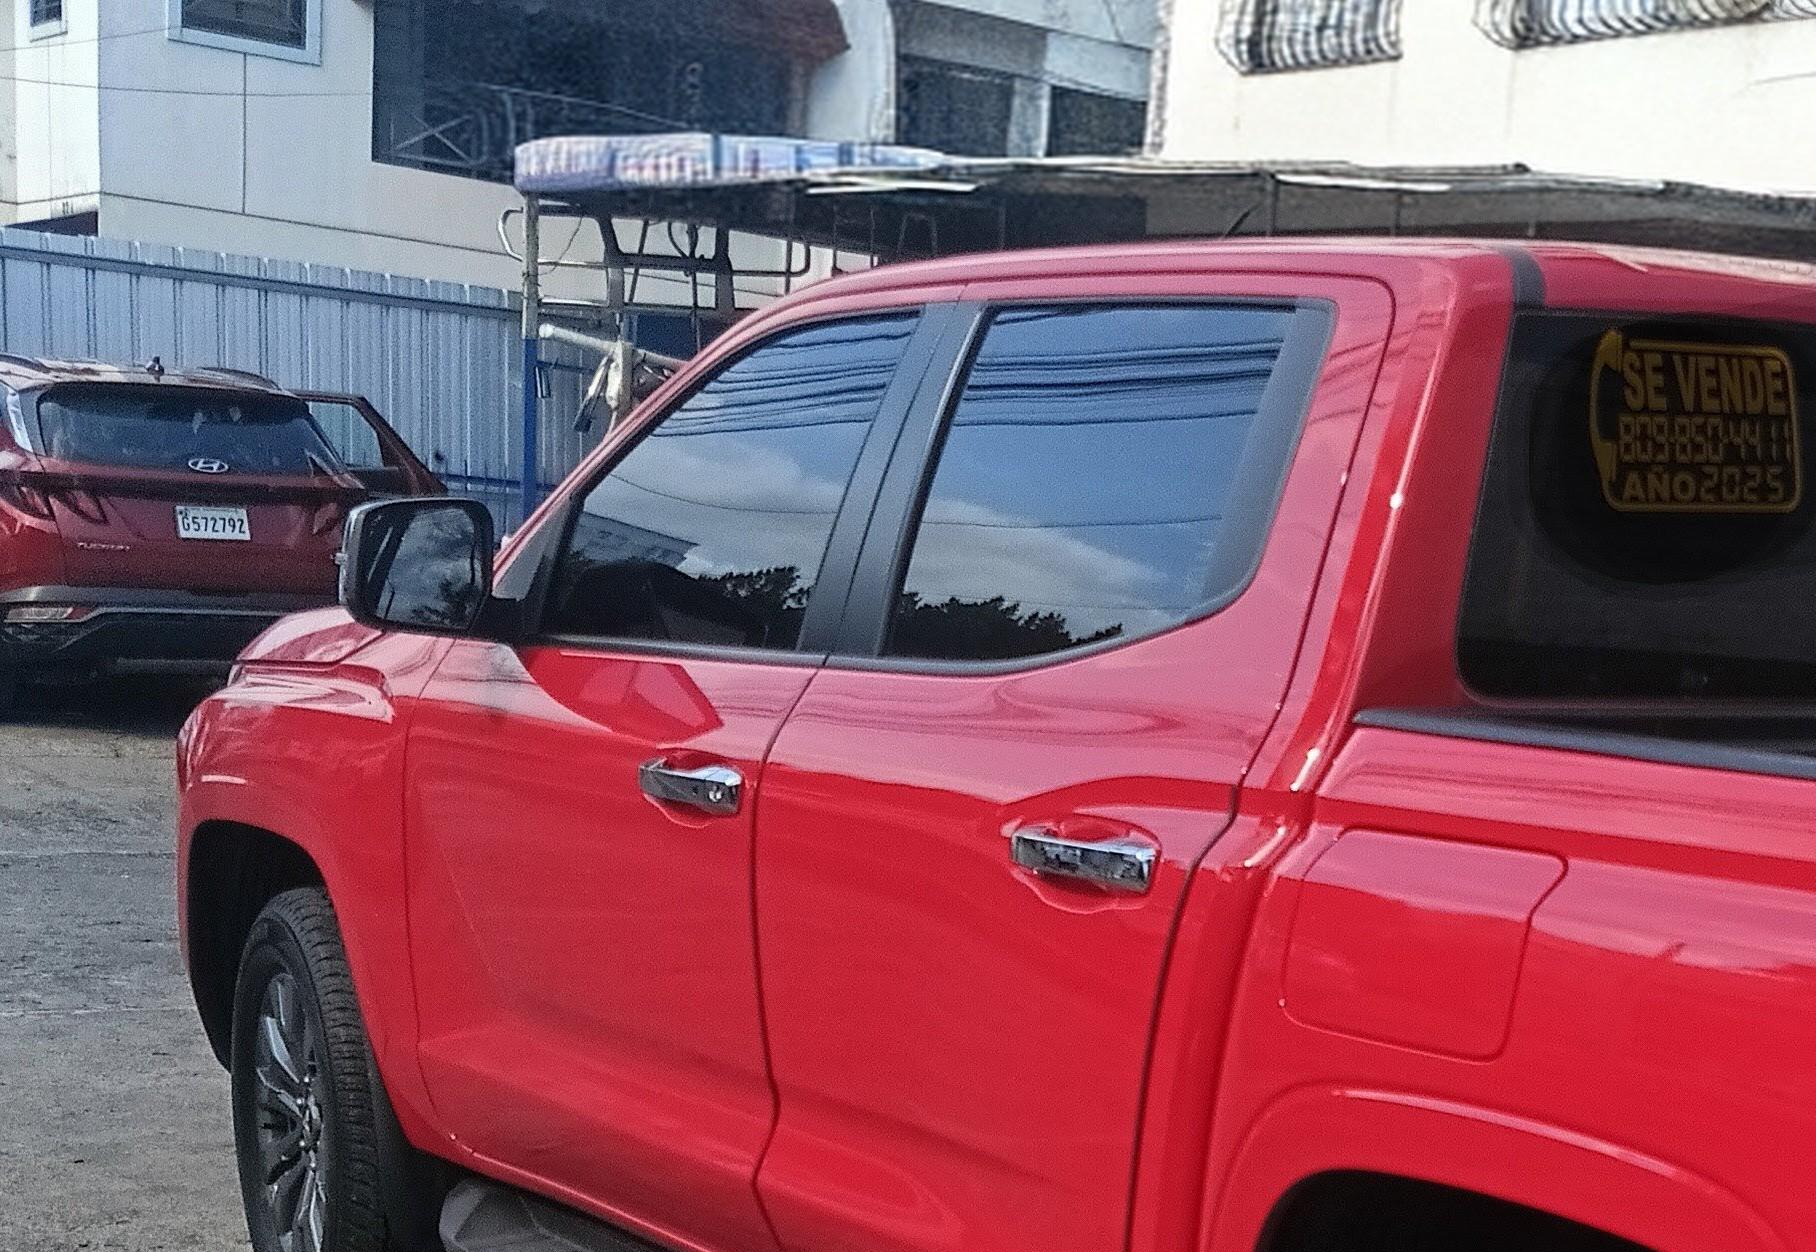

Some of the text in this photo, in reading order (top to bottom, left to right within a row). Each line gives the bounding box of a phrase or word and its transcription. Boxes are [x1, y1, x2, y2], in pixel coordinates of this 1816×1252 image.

[1621, 351, 1787, 416] SE VENDE
[1621, 464, 1785, 502] AÑO 2025
[181, 516, 246, 534] G572792
